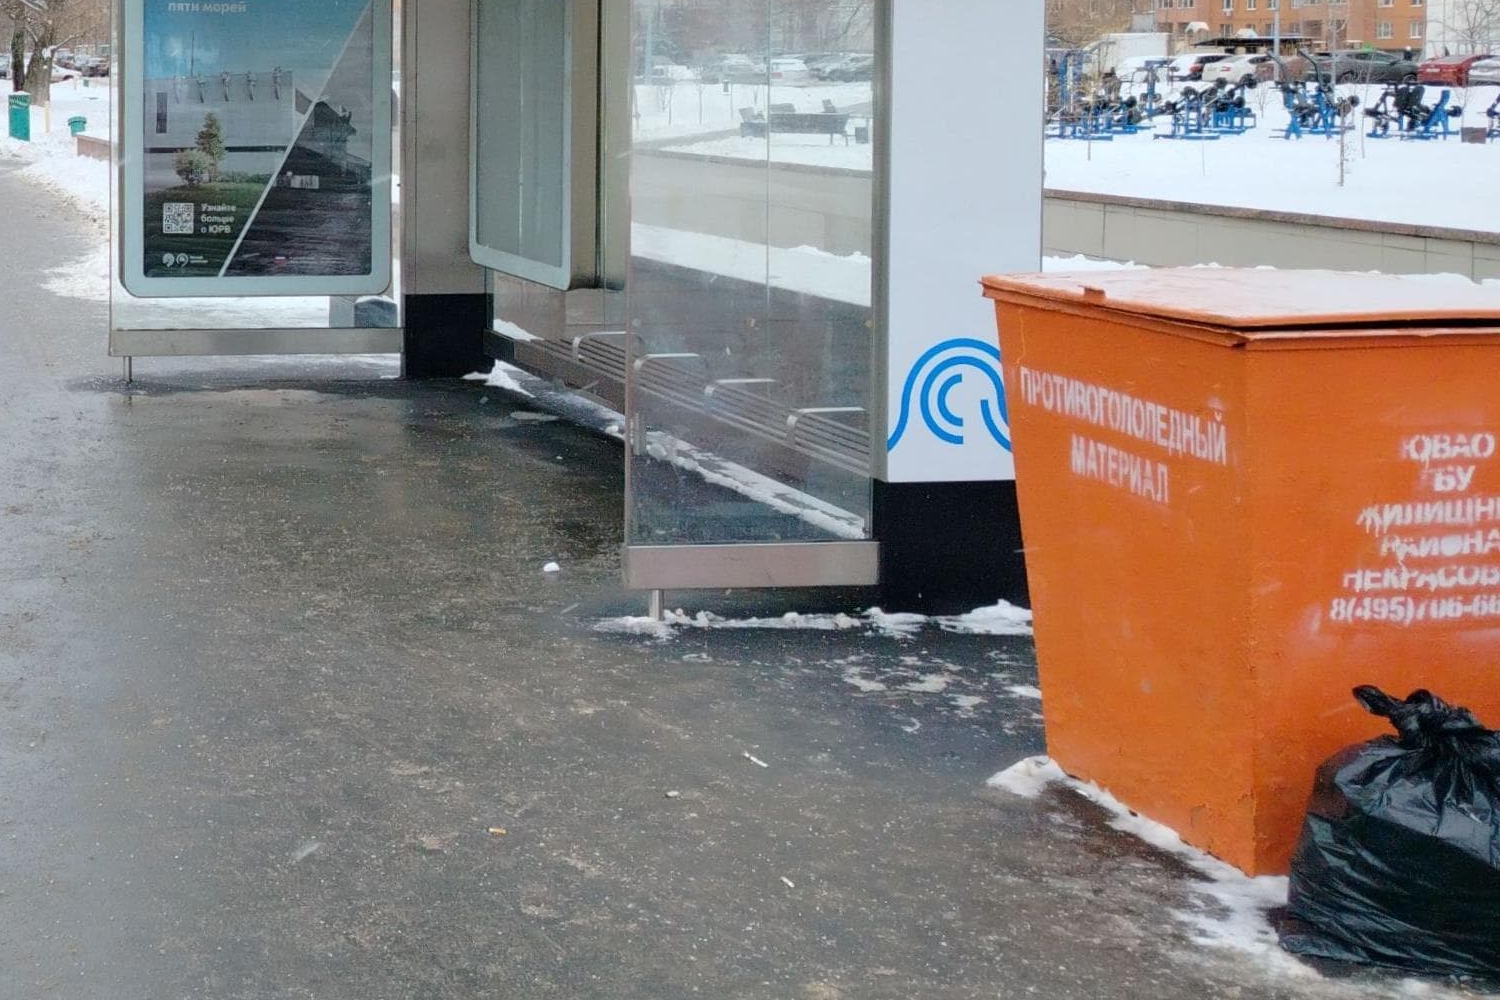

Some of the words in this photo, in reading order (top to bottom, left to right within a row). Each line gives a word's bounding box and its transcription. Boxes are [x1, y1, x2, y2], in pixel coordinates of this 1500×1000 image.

[168, 2, 199, 12] пяти
[202, 1, 246, 15] морей
[201, 203, 236, 212] Узнайте
[1020, 366, 1227, 466] ПРОТИВОГОЛОЛЕДНЫЙ
[1070, 433, 1170, 503] МАТЕРИАЛ
